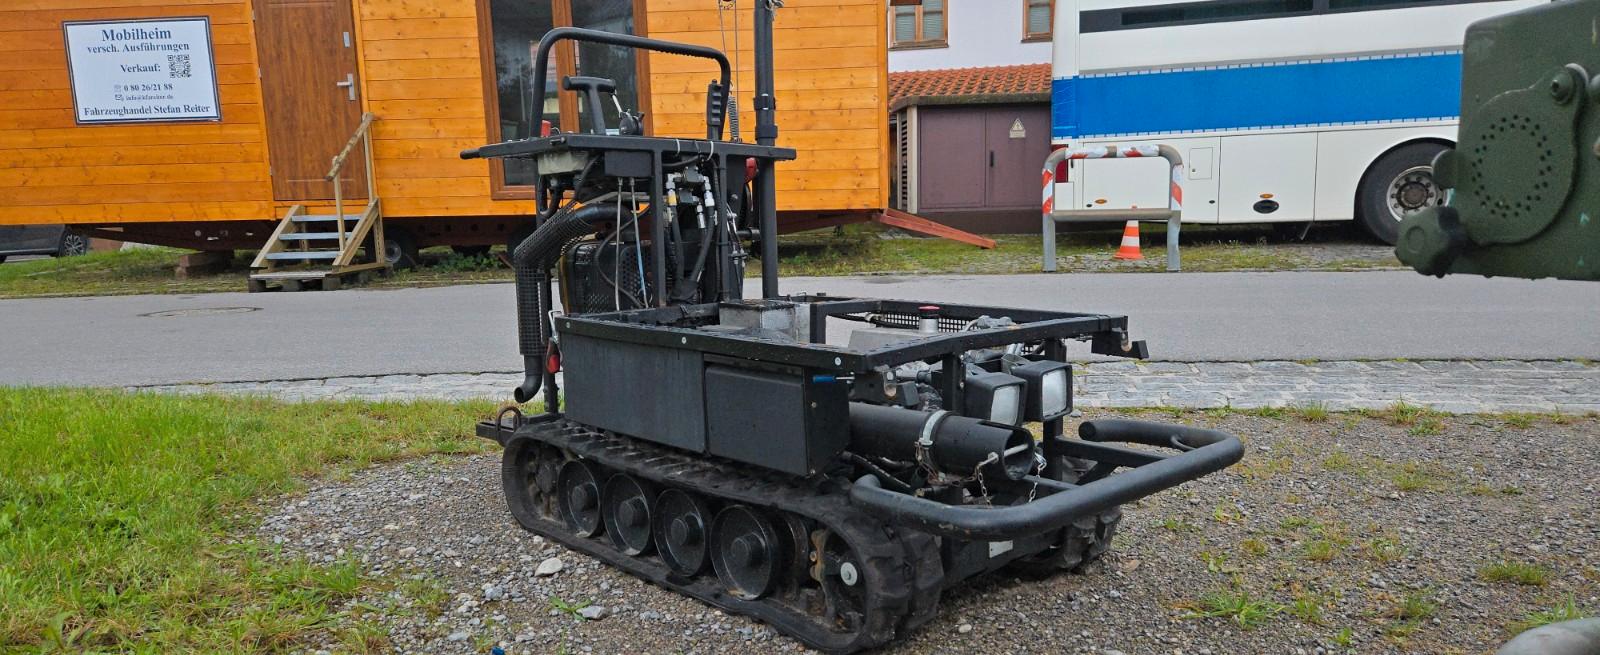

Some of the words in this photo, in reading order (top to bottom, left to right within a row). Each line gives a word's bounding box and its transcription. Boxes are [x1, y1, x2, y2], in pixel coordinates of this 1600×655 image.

[102, 27, 172, 41] Mobilheim
[87, 44, 120, 53] versch.
[122, 42, 190, 52] Ausführungen
[120, 64, 161, 73] Verkauf:
[84, 105, 152, 117] Fahrzeughandel
[153, 105, 181, 114] Stefan
[183, 104, 210, 113] Reiter
